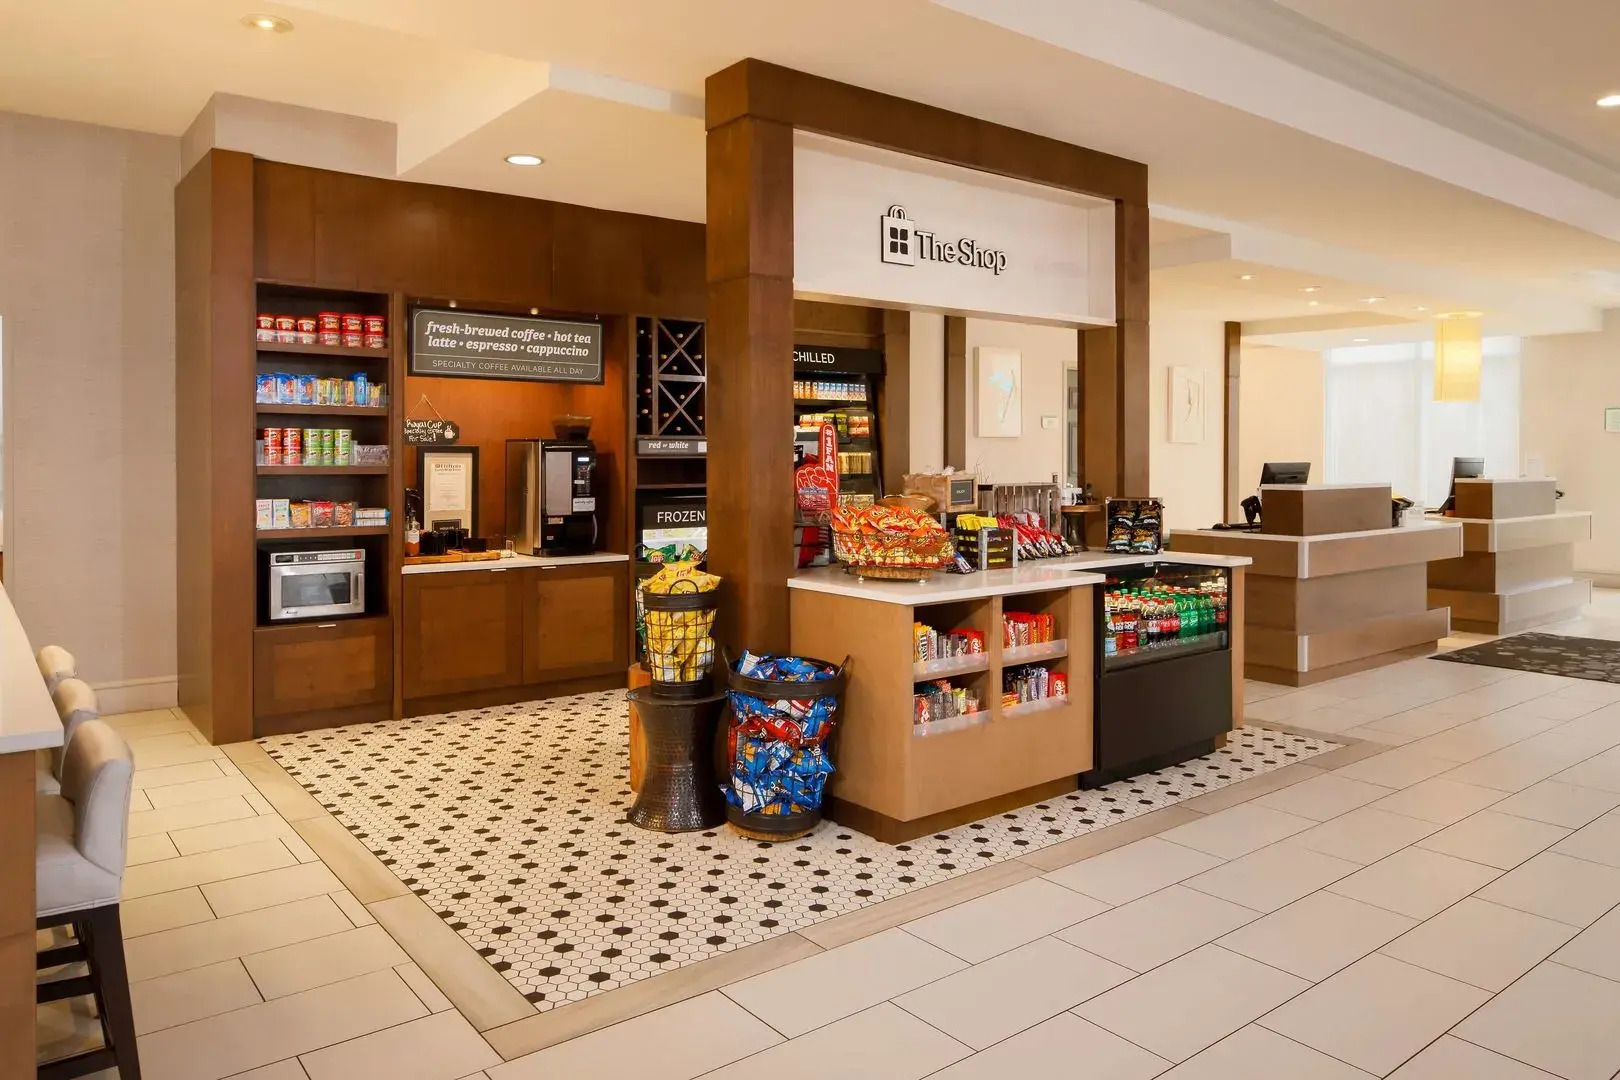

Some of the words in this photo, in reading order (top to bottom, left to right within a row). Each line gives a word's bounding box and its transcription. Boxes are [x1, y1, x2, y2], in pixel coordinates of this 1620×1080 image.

[914, 230, 956, 263] The
[957, 238, 1007, 276] Shop
[424, 320, 509, 338] fresh-brewed
[511, 328, 546, 342] coffee
[553, 330, 573, 342] hot
[574, 333, 592, 344] tea
[428, 336, 457, 348] latte
[466, 340, 518, 352] espresso
[526, 345, 589, 357] cappuccino
[792, 350, 835, 364] CHILLED
[432, 360, 476, 369] SPECIALTY
[478, 362, 509, 371] COFFEE
[511, 364, 552, 373] AVAILABLE
[553, 367, 568, 375] ALL
[569, 367, 584, 375] DAY
[648, 441, 661, 449] red
[668, 441, 689, 449] white
[657, 510, 706, 523] FROZEN
